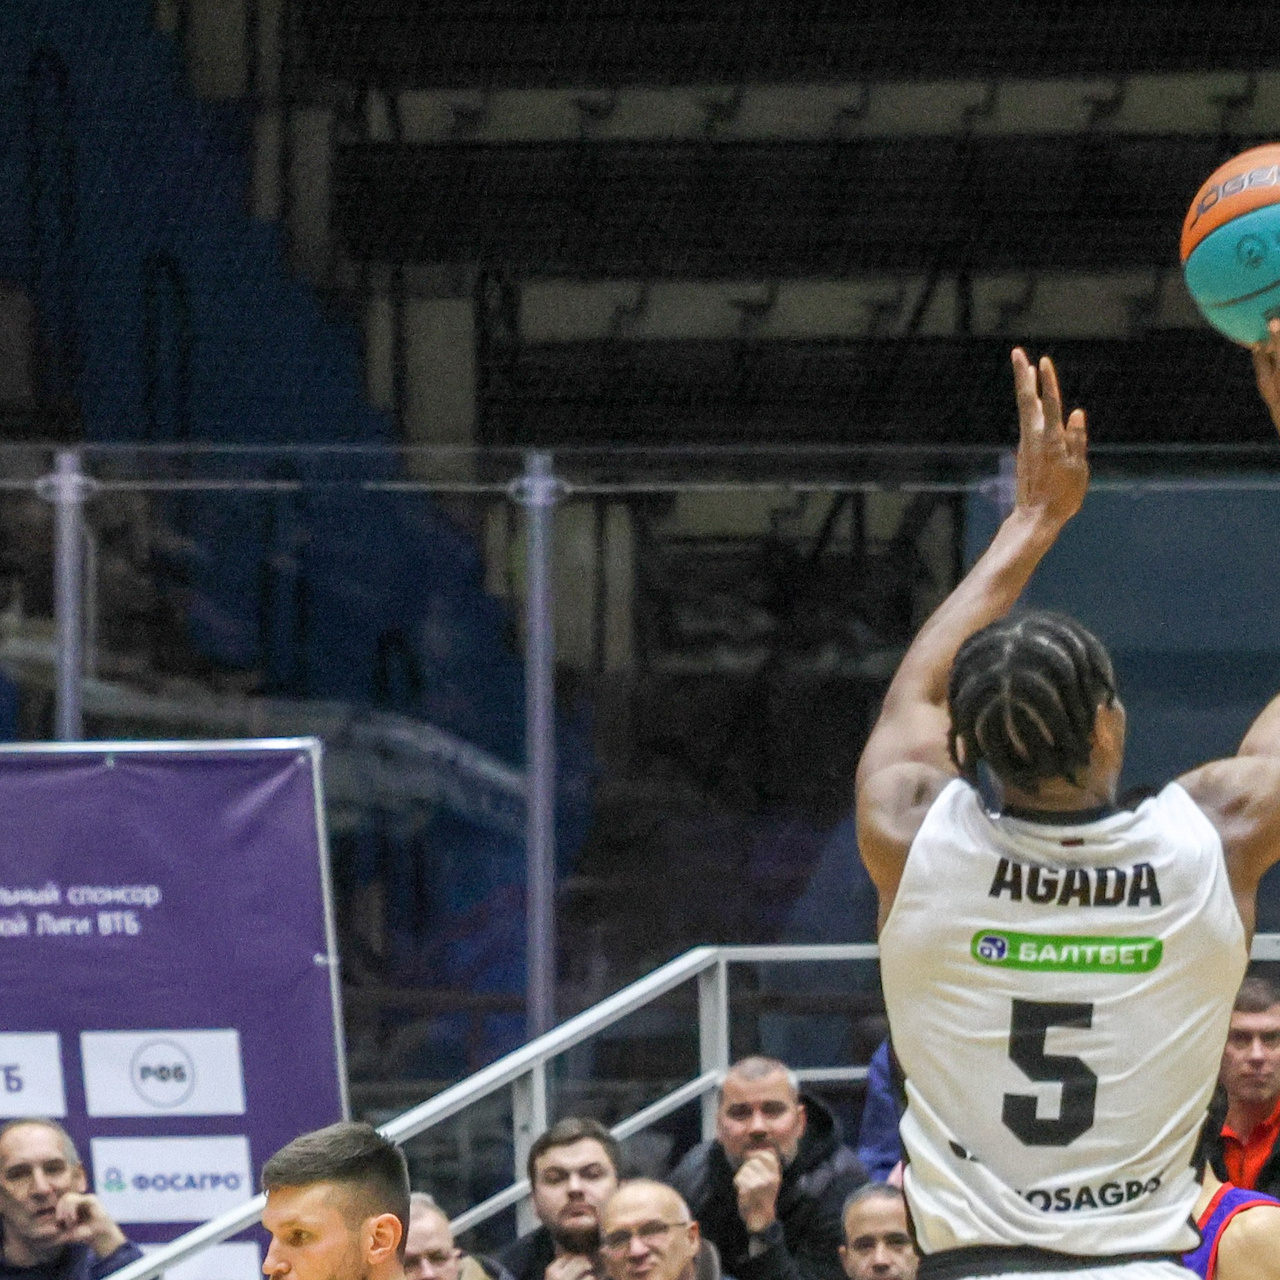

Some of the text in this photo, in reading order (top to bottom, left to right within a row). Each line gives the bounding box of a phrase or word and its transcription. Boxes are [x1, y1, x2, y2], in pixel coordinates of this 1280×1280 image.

[988, 857, 1162, 907] AGADA
[67, 885, 163, 908] спонсор
[37, 911, 92, 936] Лиги
[98, 910, 142, 936] ВТБ
[1018, 940, 1156, 965] БАЛТБЕТ
[0, 1064, 24, 1092] Б
[140, 1065, 187, 1082] РФБ
[1001, 997, 1097, 1147] 5
[131, 1172, 242, 1192] ФОСАГРО
[1015, 1176, 1161, 1212] OSAGRO
